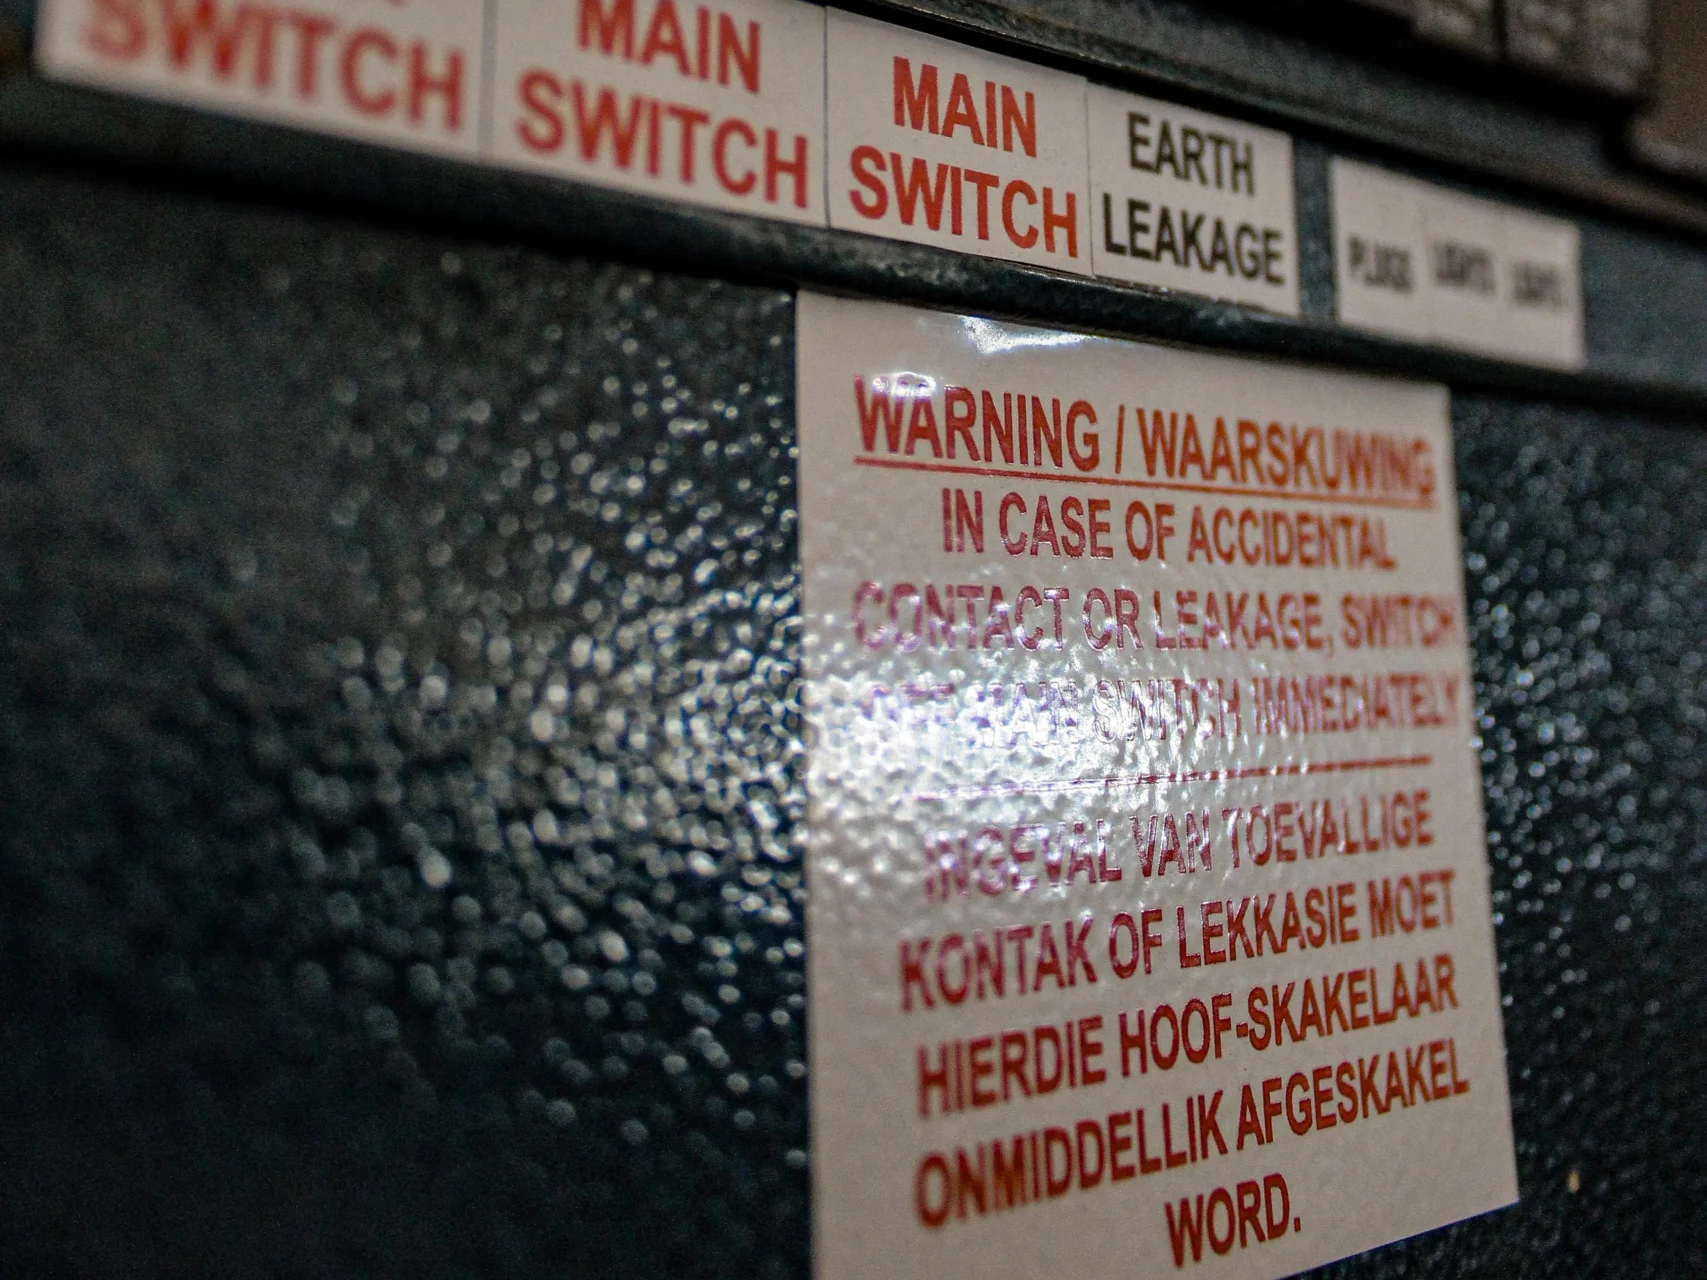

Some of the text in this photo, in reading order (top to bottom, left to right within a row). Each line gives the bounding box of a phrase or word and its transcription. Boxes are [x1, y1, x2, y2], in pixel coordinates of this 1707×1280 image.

[516, 68, 809, 209] SWITCH
[893, 55, 1038, 158] MAIN
[1126, 110, 1256, 198] EARTH
[849, 144, 1078, 258] SWITCH
[1102, 191, 1286, 285] LEAKAGE
[853, 373, 1101, 471] WARNING
[1136, 406, 1436, 497] WAARSKUWING
[942, 488, 1397, 569] IN CASE OF ACCIDENTAL
[854, 580, 1455, 658] CONTACT OR LEAKAGE, SWITCH
[1091, 678, 1241, 742] SWITCH
[1251, 673, 1459, 736] IMMEDIATELY
[1128, 810, 1212, 877] VAN
[1220, 788, 1433, 869] TOEVALLIGE
[900, 869, 1456, 1012] KONTAK OF LEKKASIE MOET
[917, 952, 1459, 1118] HIERDIE HOOF-SKAKELAAR
[913, 1037, 1471, 1228] ONMIDDELLIK AFGESKAKEL
[1164, 1172, 1302, 1269] WORD.
